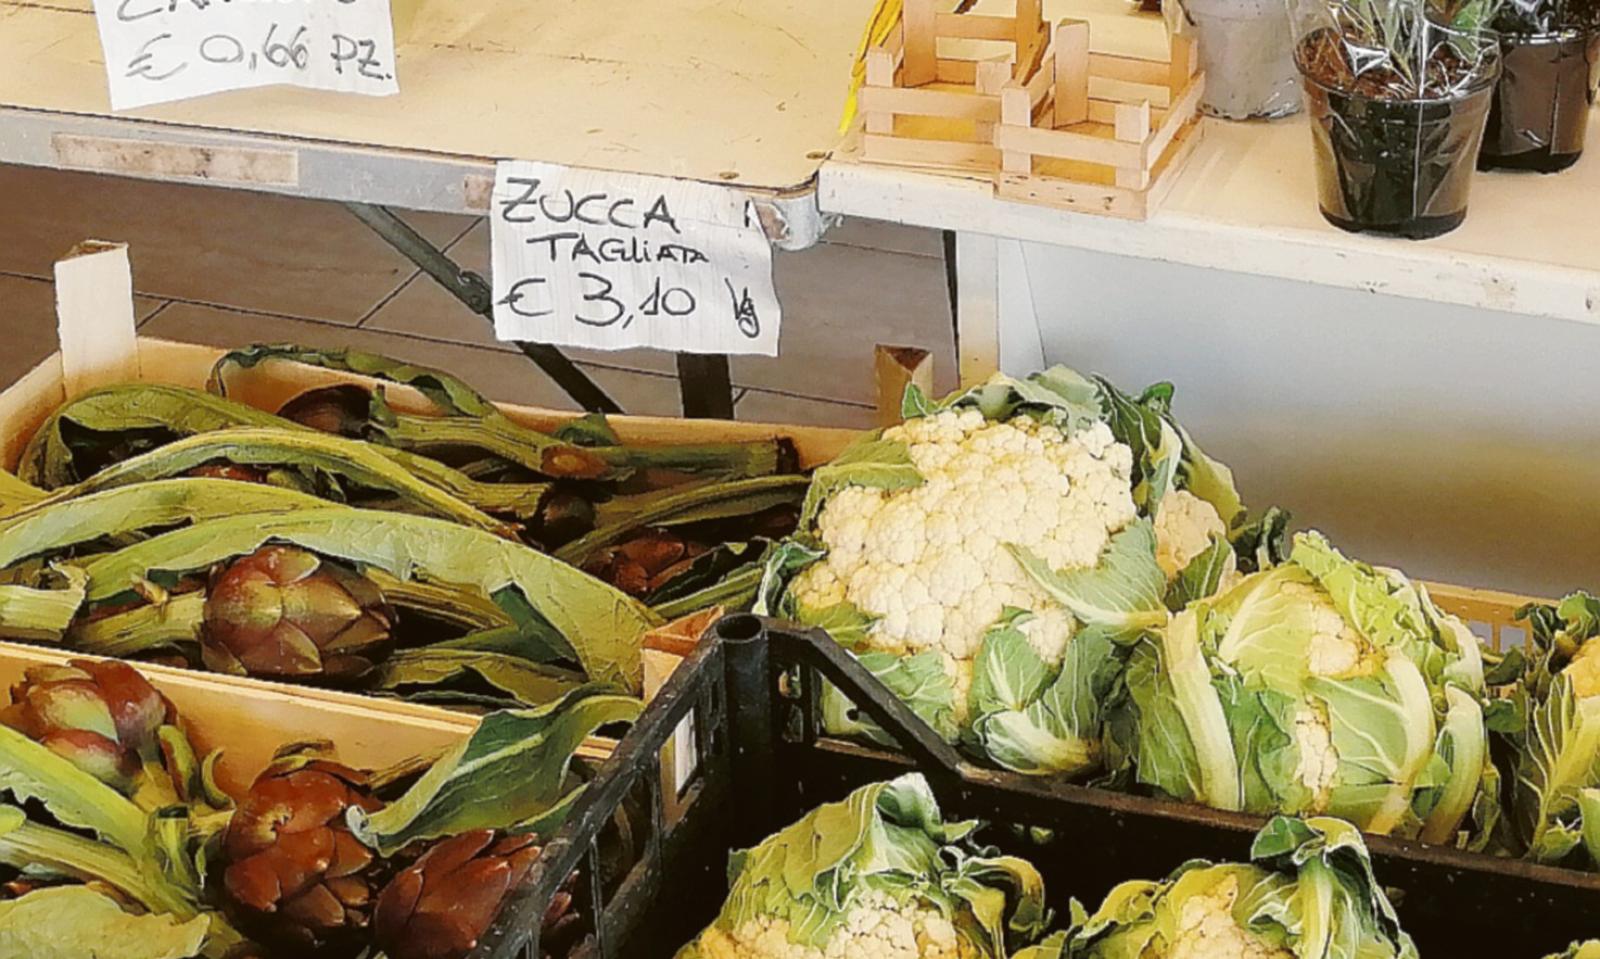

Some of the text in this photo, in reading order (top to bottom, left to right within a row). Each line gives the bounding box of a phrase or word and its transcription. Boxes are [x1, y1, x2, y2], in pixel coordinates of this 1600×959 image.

[124, 23, 392, 81] € 0,66 PZ.
[499, 176, 682, 234] ZUCCA
[497, 277, 554, 317] €
[574, 272, 697, 329] 3,10
